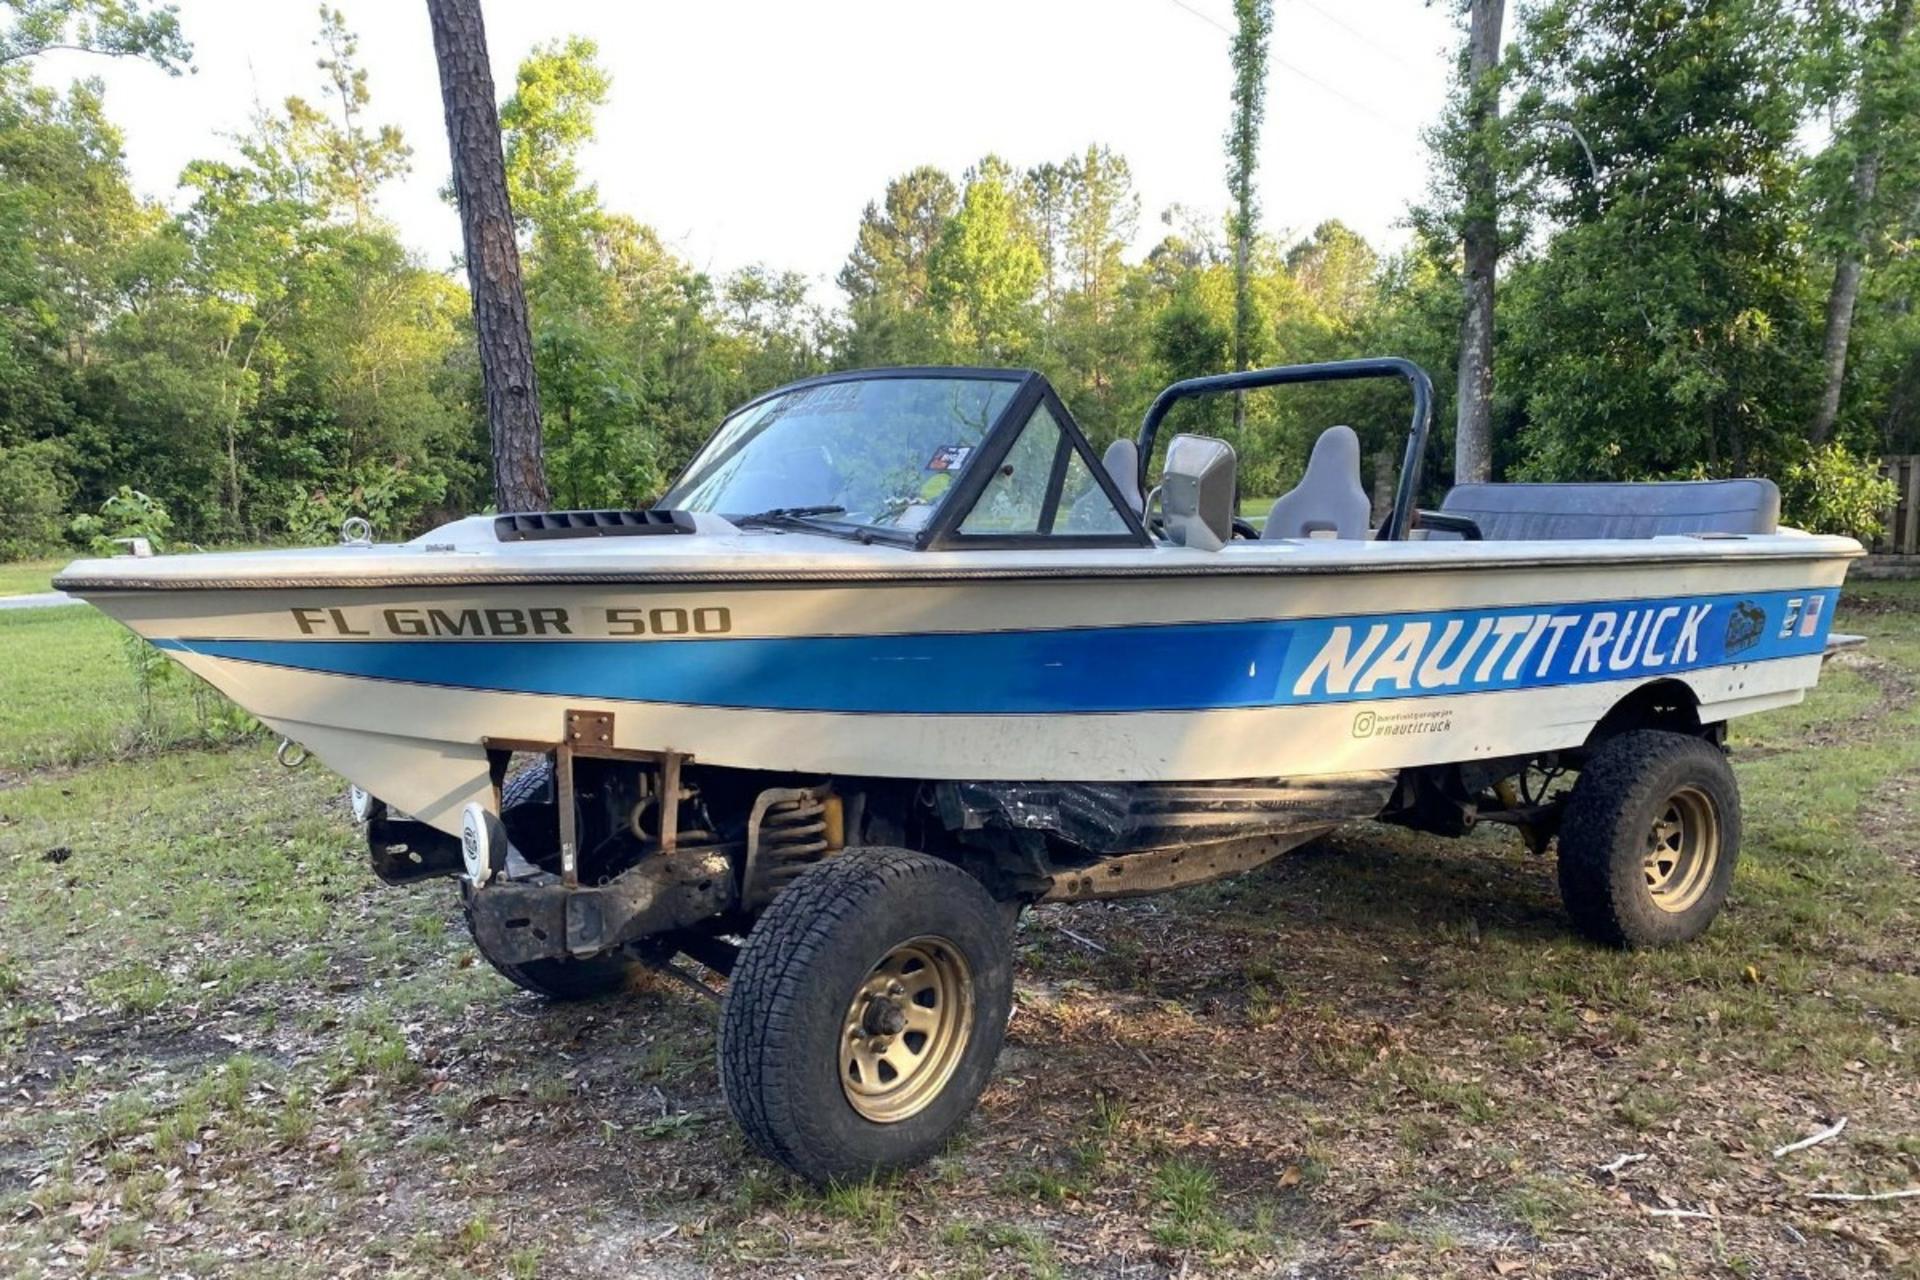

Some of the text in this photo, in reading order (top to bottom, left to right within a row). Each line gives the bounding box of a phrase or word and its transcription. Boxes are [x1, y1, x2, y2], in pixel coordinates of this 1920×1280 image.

[290, 606, 732, 636] FL GMBR 500
[1375, 719, 1451, 736] #nautitruck
